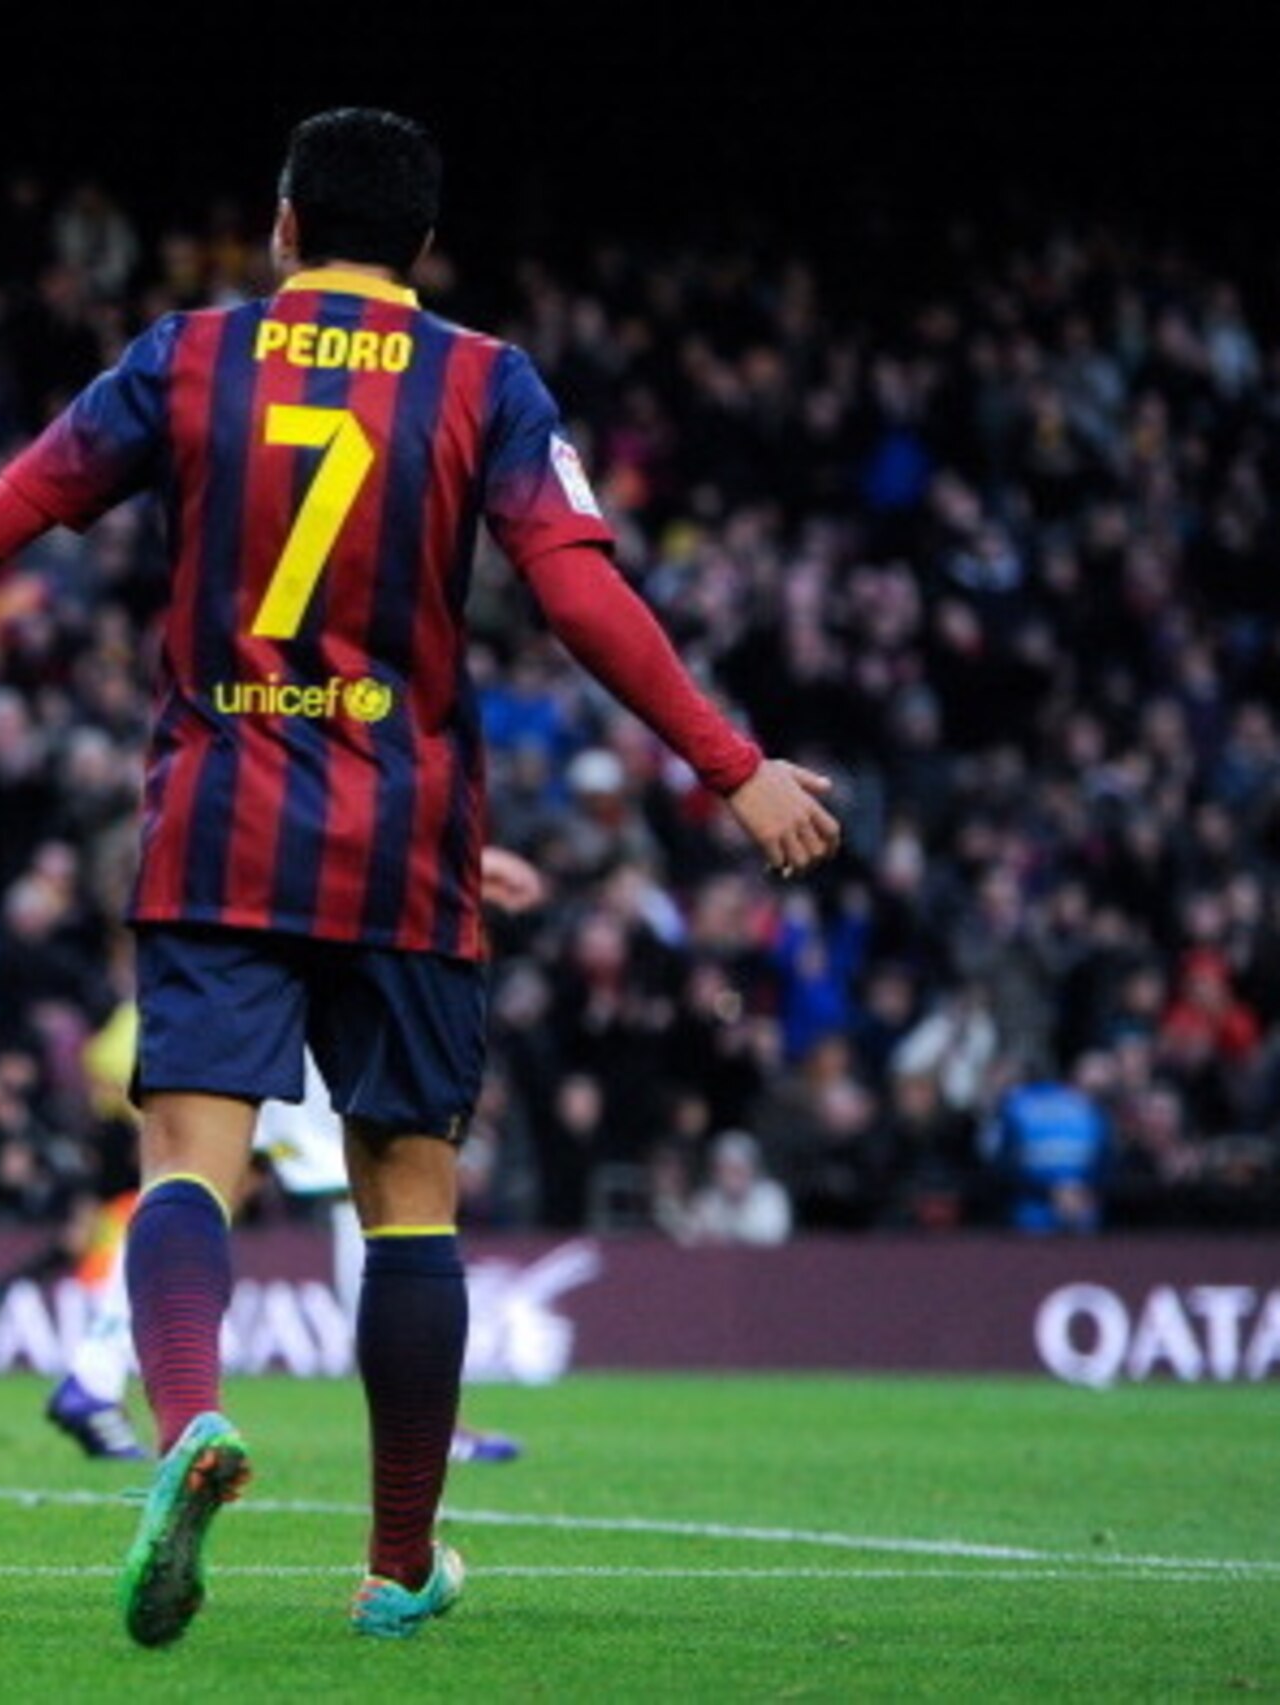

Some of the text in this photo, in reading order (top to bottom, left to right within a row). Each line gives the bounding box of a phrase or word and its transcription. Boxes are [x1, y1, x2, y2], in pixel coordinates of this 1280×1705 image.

[255, 319, 413, 373] PEDRO
[252, 404, 375, 640] 7
[214, 672, 342, 718] unicef
